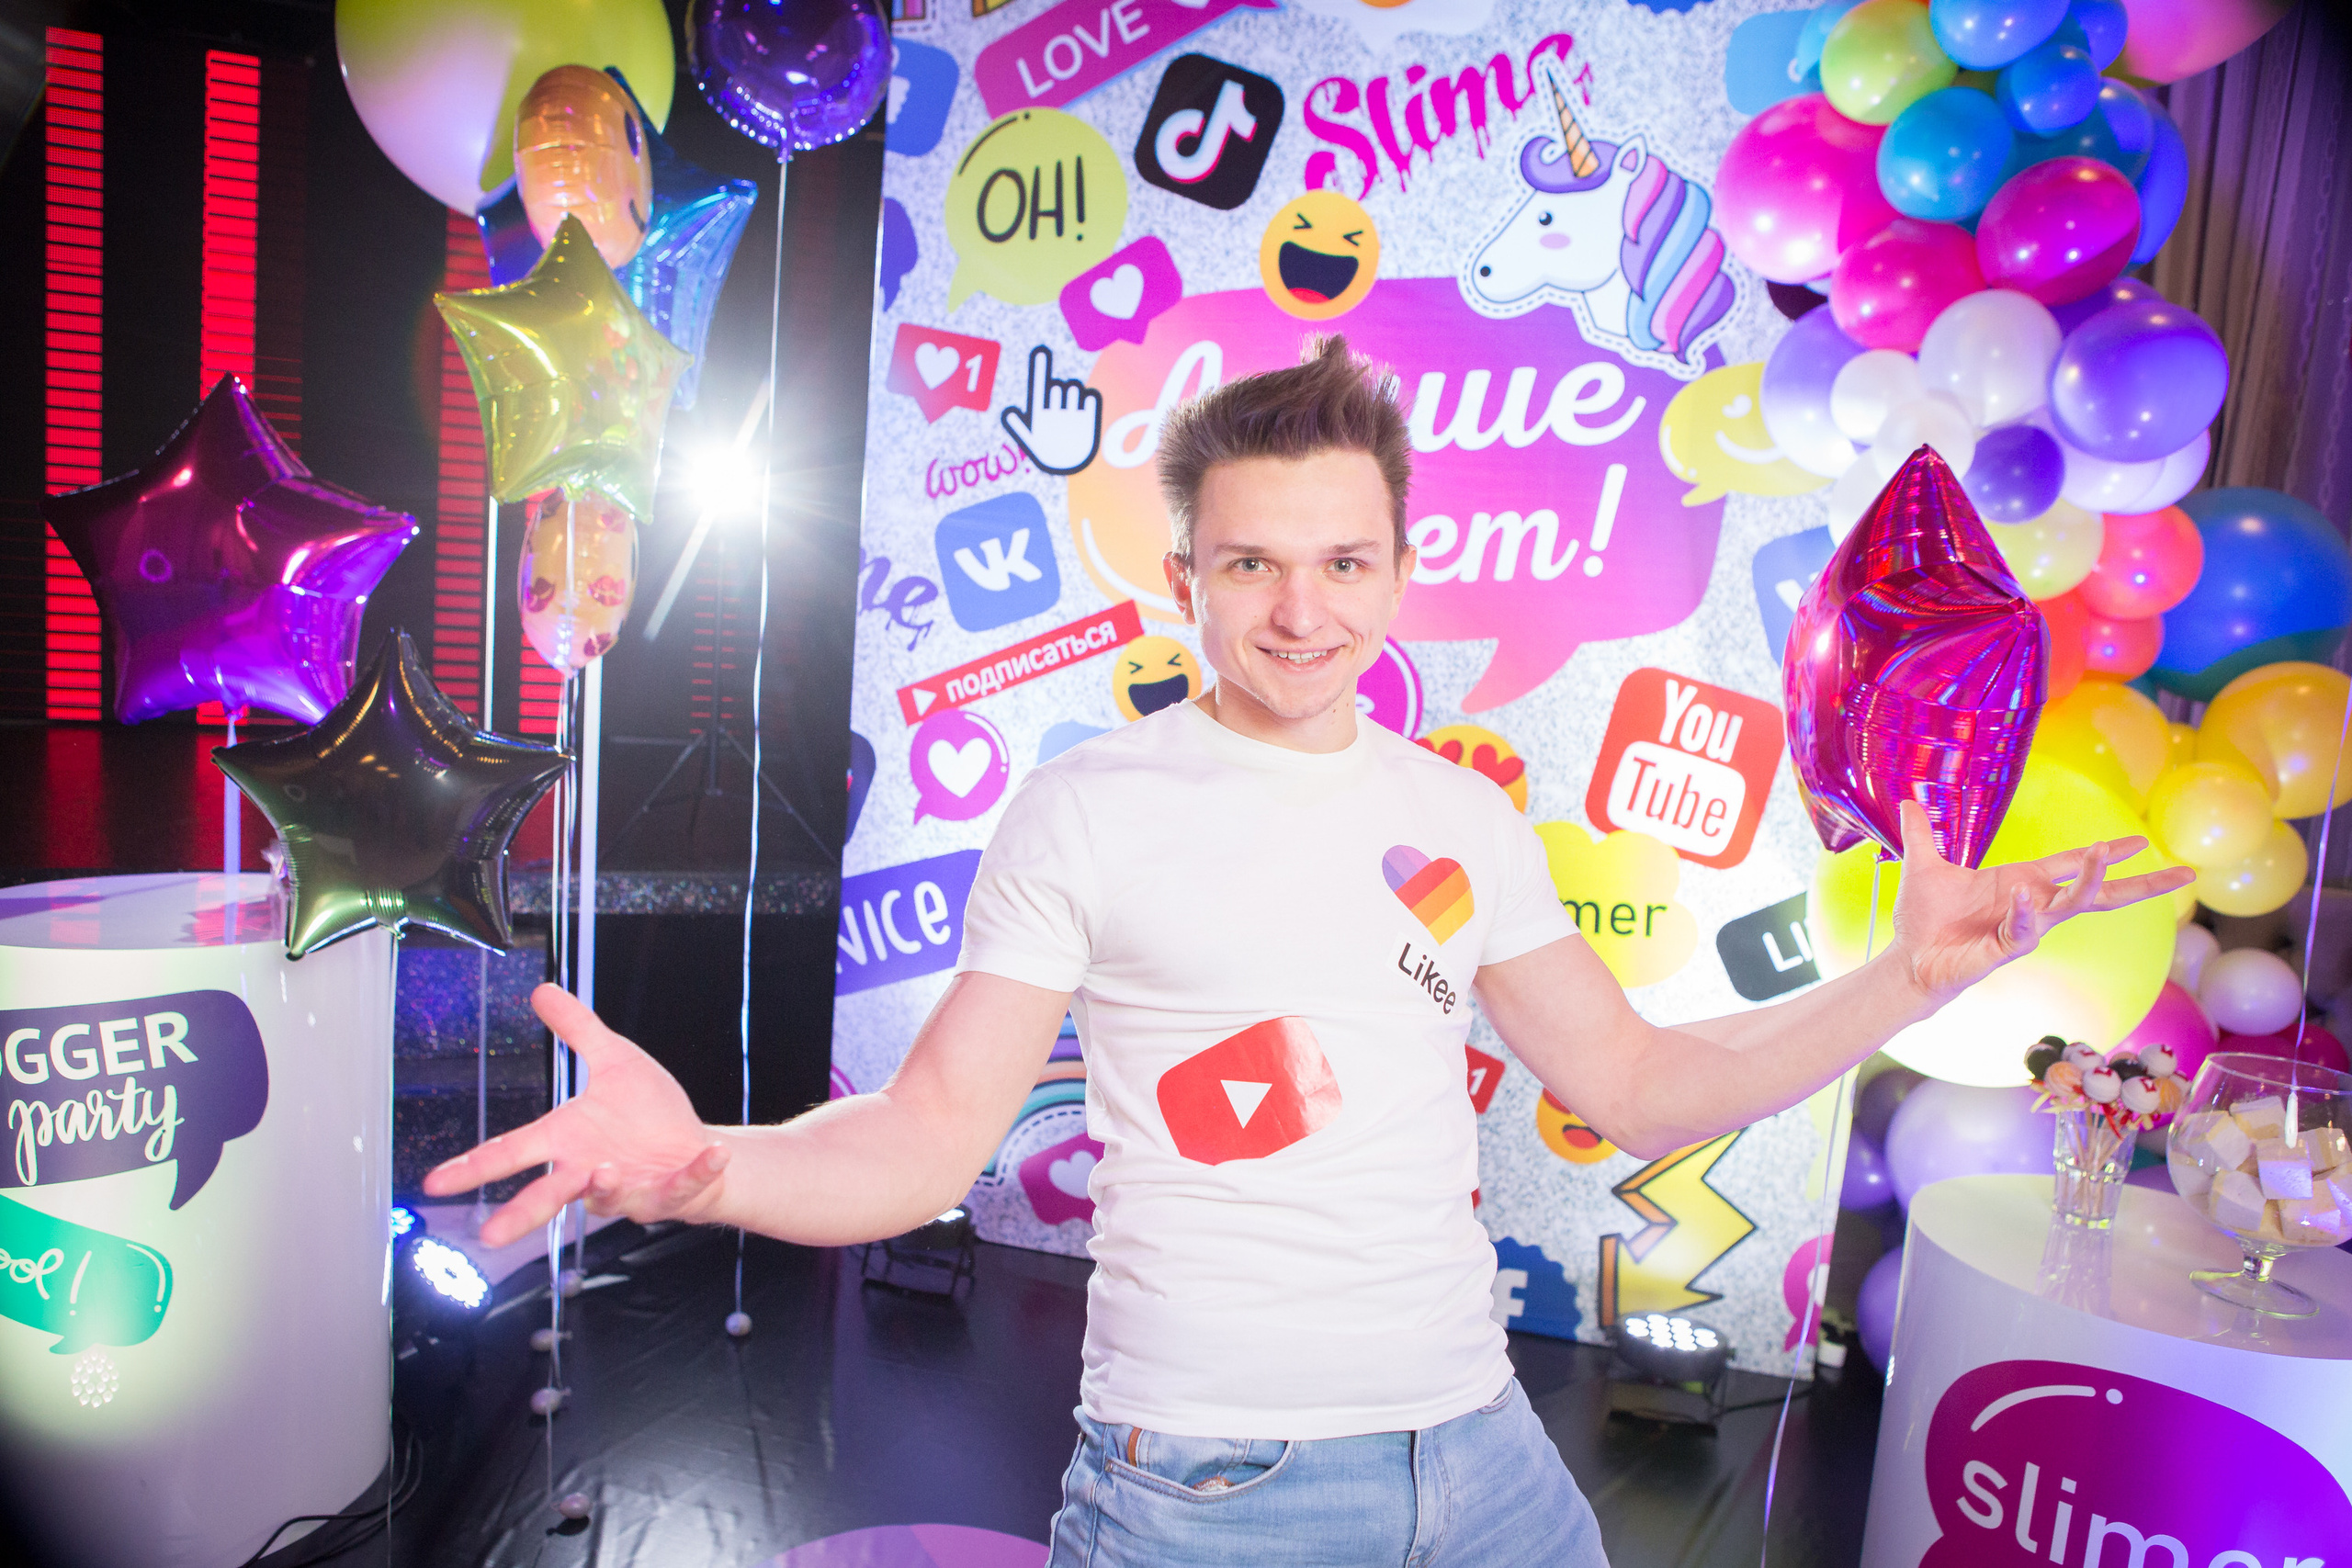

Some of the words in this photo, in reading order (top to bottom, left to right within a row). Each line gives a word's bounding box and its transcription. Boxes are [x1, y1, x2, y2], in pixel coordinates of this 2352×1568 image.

[1016, 0, 1149, 98] LOVE
[976, 154, 1086, 243] OH!
[1657, 679, 1745, 763] You
[1625, 755, 1728, 839] Tube
[1560, 899, 1668, 937] mer
[1397, 942, 1457, 1015] Likee
[0, 1010, 199, 1085] GGER
[8, 1076, 186, 1187] party
